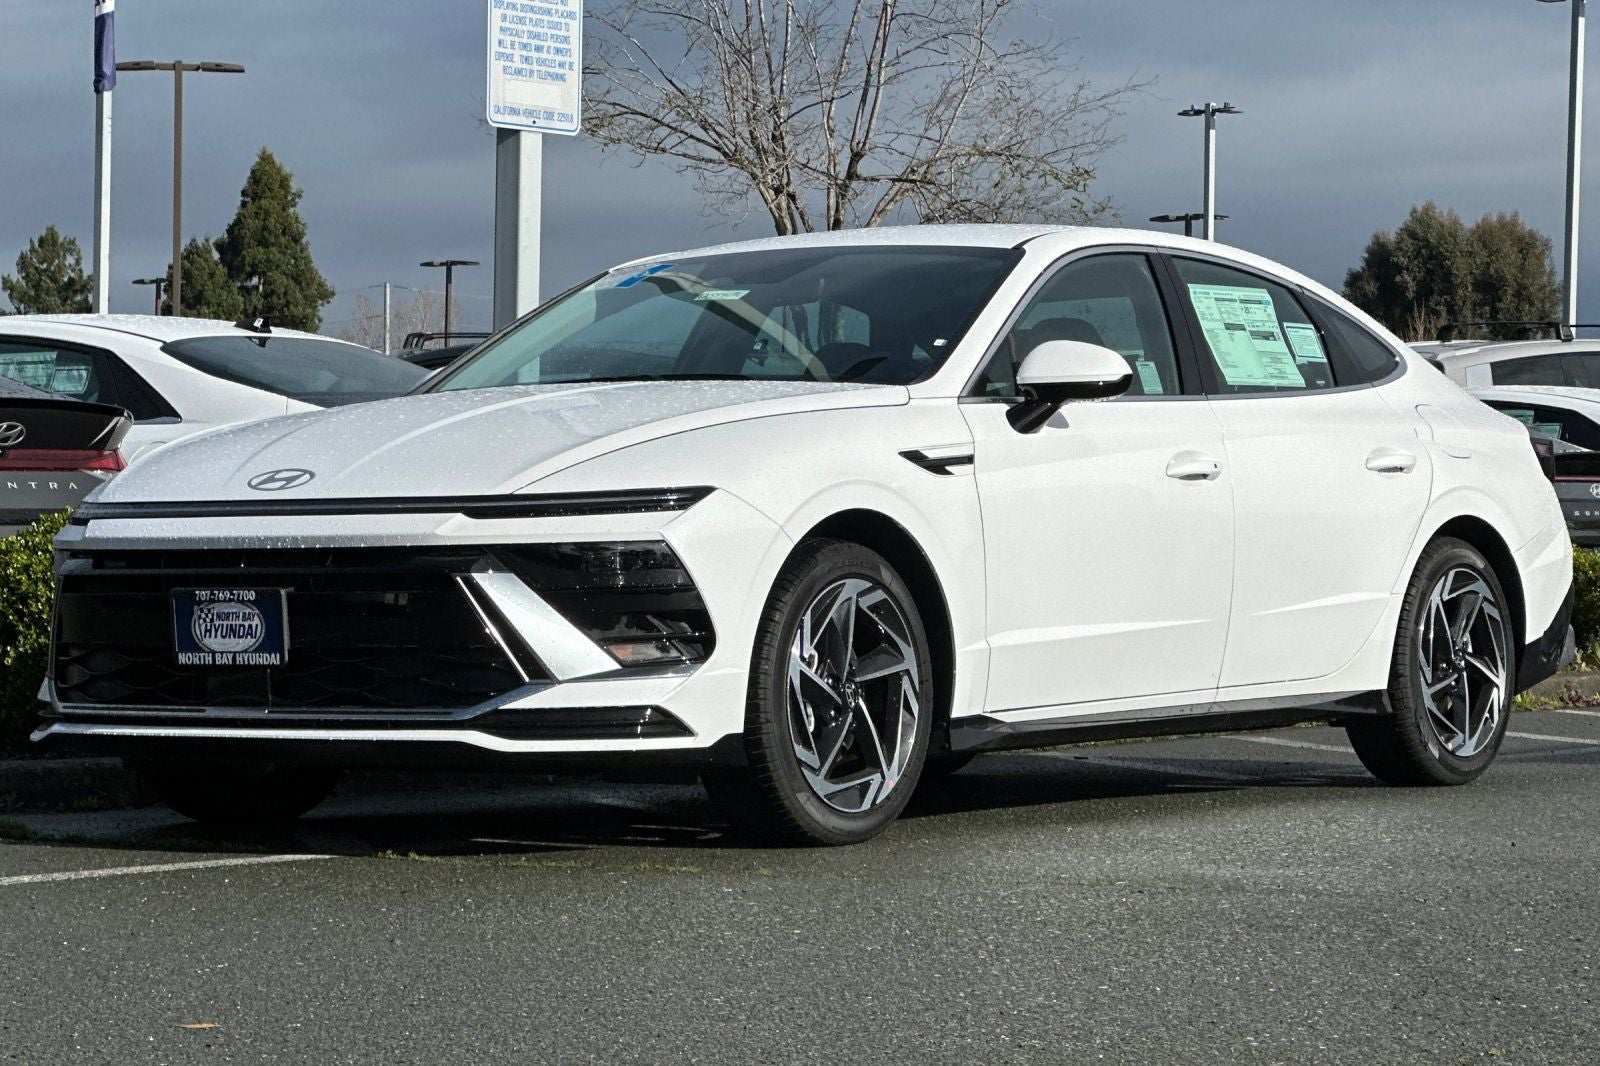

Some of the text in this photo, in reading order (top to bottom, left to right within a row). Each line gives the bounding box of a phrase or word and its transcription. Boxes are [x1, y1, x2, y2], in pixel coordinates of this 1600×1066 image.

[501, 13, 570, 32] OR LICENSE PLATES ISSUED TO
[499, 26, 571, 45] PHYSICALLY DISABLED PERSONS
[498, 39, 508, 49] WILL
[510, 40, 516, 50] BE
[518, 42, 532, 52] TOWED
[534, 44, 545, 54] AWAY
[546, 45, 552, 54] AT
[519, 54, 534, 65] TOWED
[535, 57, 556, 68] VEHICLES
[558, 59, 567, 69] MAY
[568, 61, 574, 71] BE
[503, 65, 567, 82] RECLAIMED BY TELEPHONING
[494, 104, 520, 116] CALIFORNIA
[522, 107, 541, 120] VEHICLE
[543, 109, 555, 121] CODE
[195, 590, 256, 601] 707-769-7700
[215, 611, 257, 622] NORTH BAY
[203, 623, 259, 640] HYUNDAI
[178, 653, 280, 665] NORTH BAY HYUNDAI
